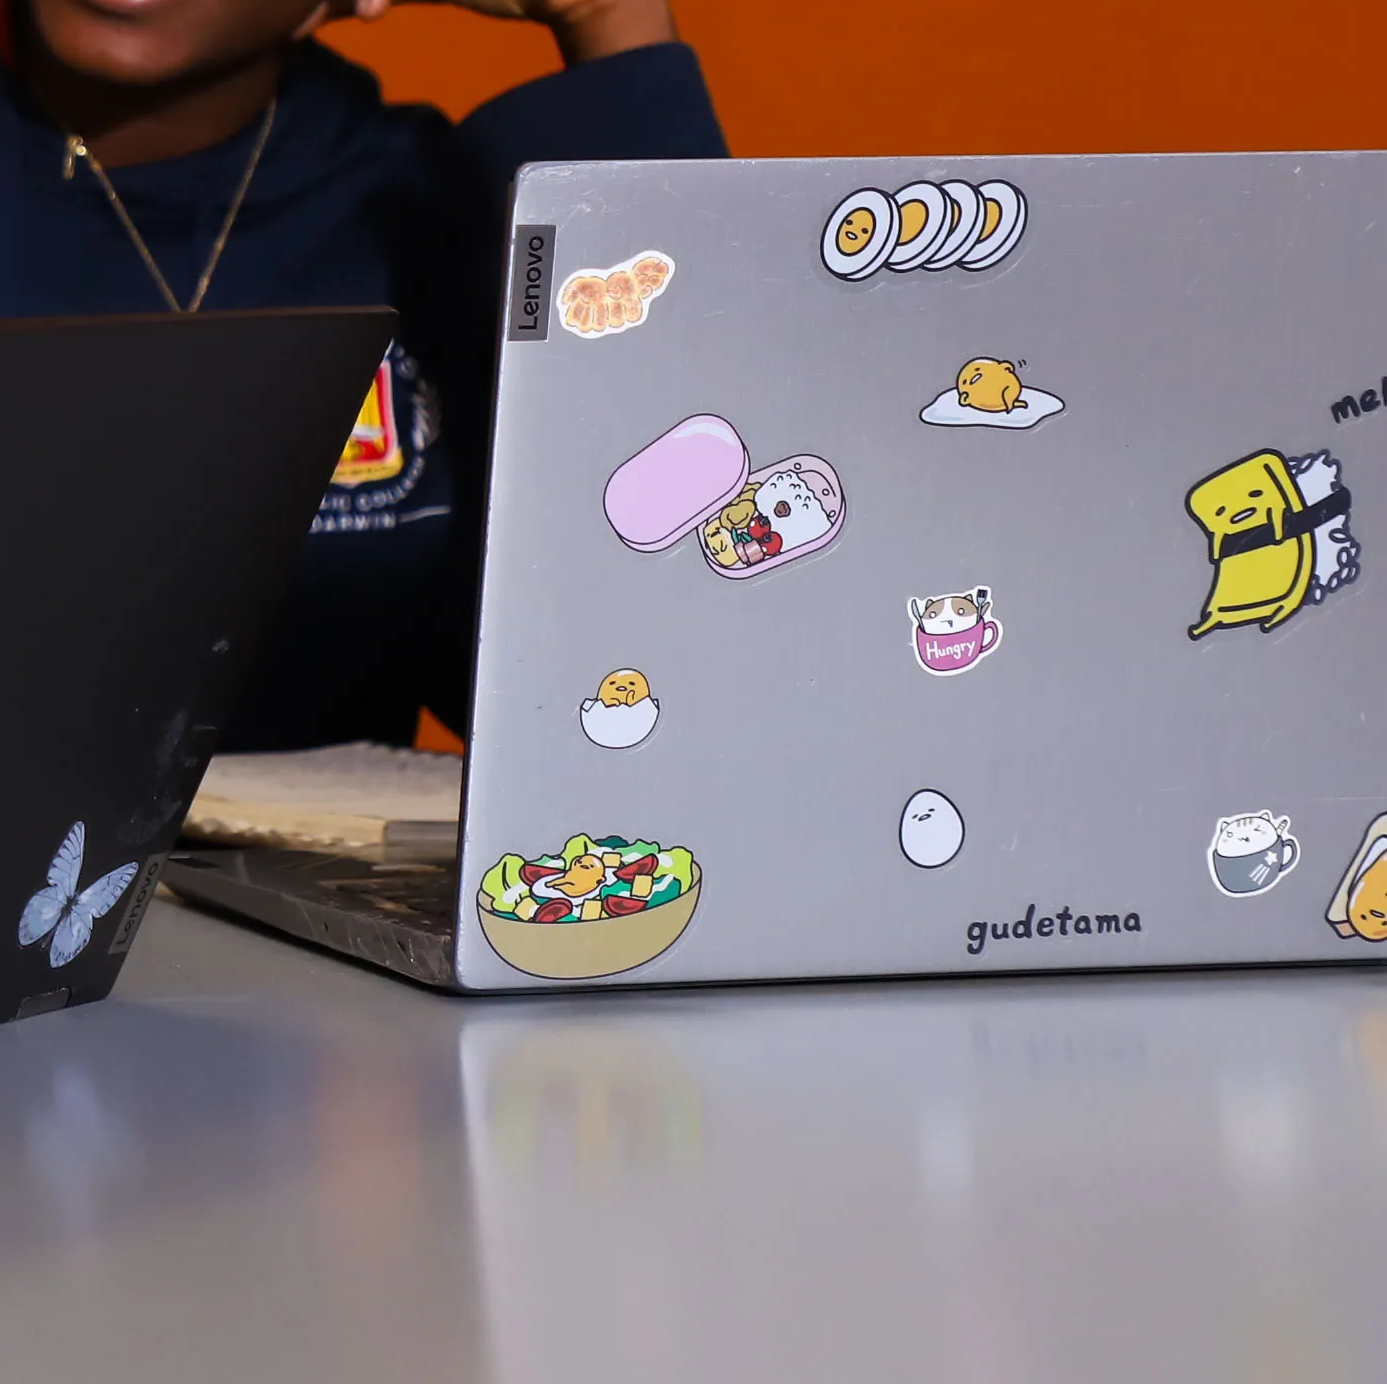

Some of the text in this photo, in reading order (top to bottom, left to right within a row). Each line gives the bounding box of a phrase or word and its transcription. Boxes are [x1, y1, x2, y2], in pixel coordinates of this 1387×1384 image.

[517, 235, 545, 331] Lenovo
[925, 640, 976, 660] Hungry
[115, 861, 159, 945] Lenovo
[966, 903, 1142, 955] gudetama
